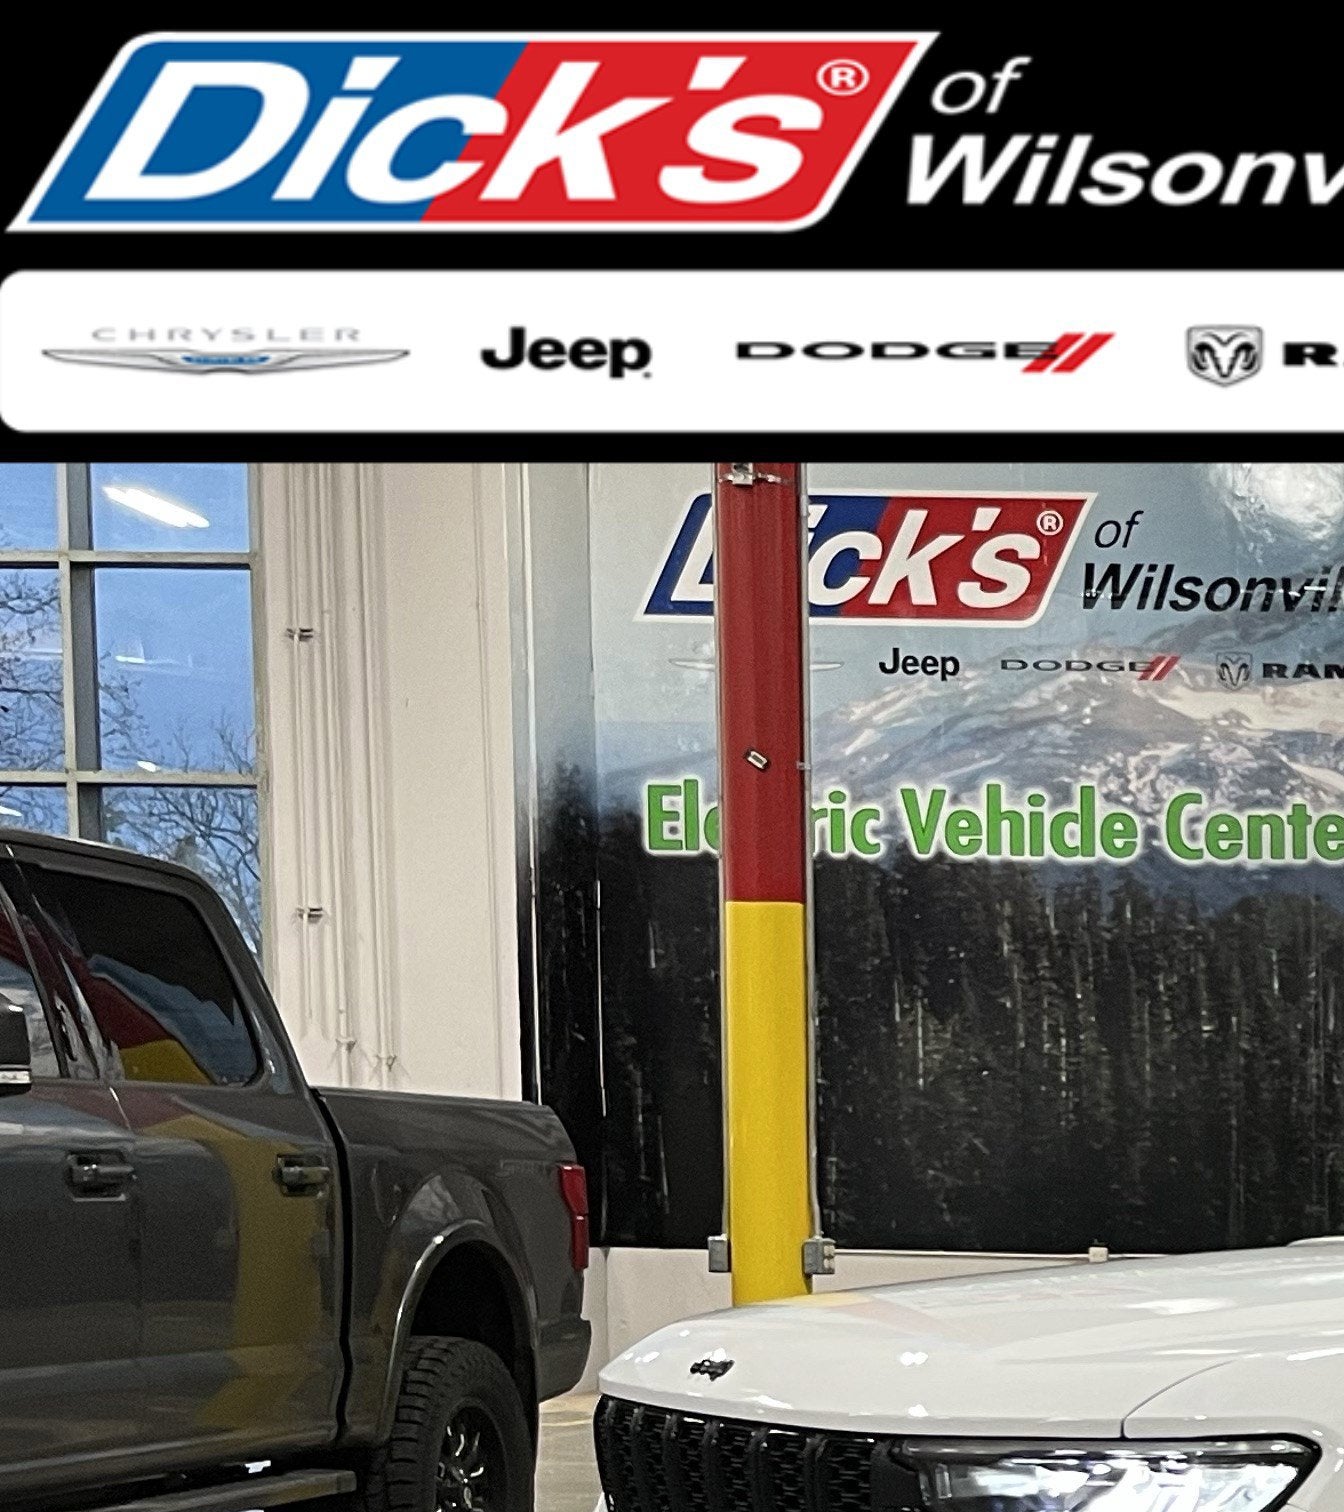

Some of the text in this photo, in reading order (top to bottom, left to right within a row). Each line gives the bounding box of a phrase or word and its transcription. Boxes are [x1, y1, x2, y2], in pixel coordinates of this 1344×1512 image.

[1094, 510, 1144, 548] of
[671, 503, 1040, 608] ck's
[878, 647, 960, 682] Jeep
[1000, 658, 1153, 673] DODGE
[647, 778, 882, 856] Elric
[901, 782, 1138, 859] Vehicle
